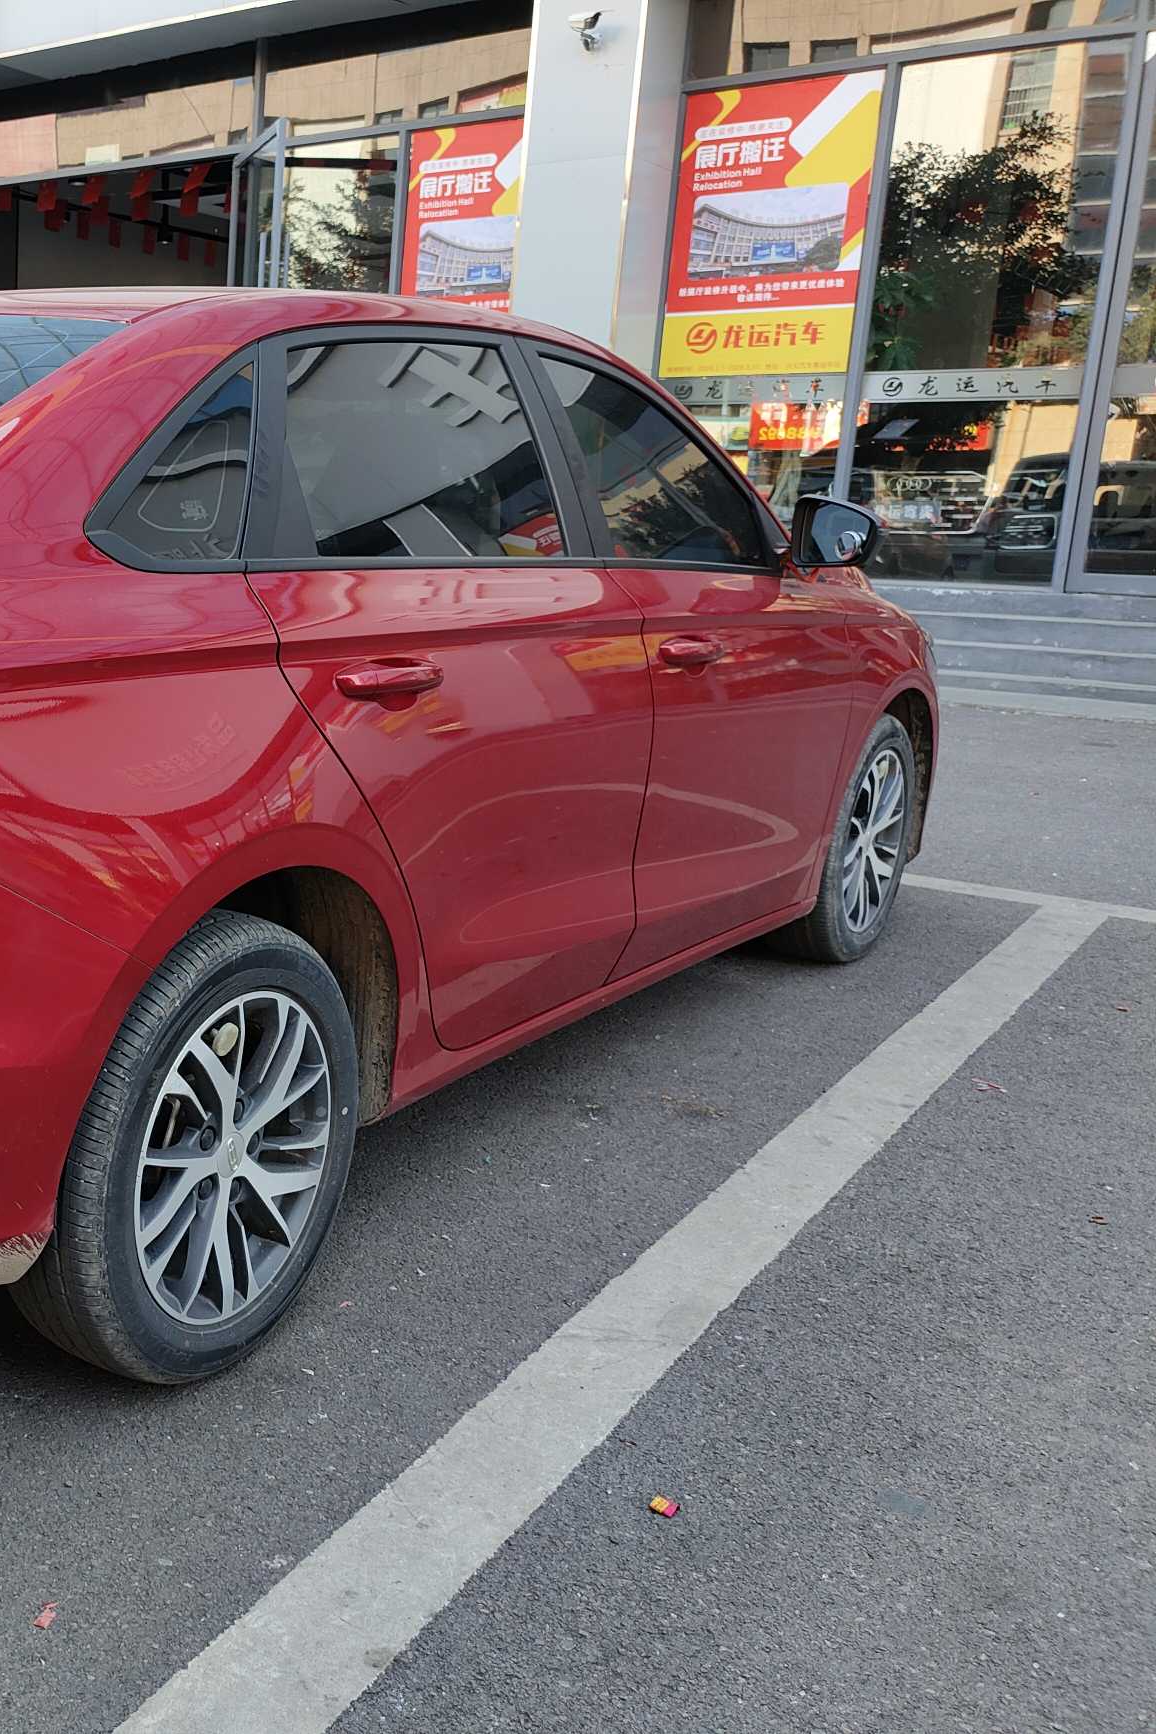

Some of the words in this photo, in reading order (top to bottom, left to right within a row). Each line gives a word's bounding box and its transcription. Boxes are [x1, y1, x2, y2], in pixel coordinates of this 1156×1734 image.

[695, 136, 786, 169] 展厅搬迁
[694, 168, 742, 182] Exhibition
[743, 166, 763, 177] Hall
[419, 171, 493, 199] 展厅搬迁
[692, 179, 743, 192] Relocation
[419, 199, 458, 210] Exhibition
[459, 197, 474, 206] Hall
[418, 209, 459, 219] Relocation
[722, 321, 827, 349] 龙运汽车
